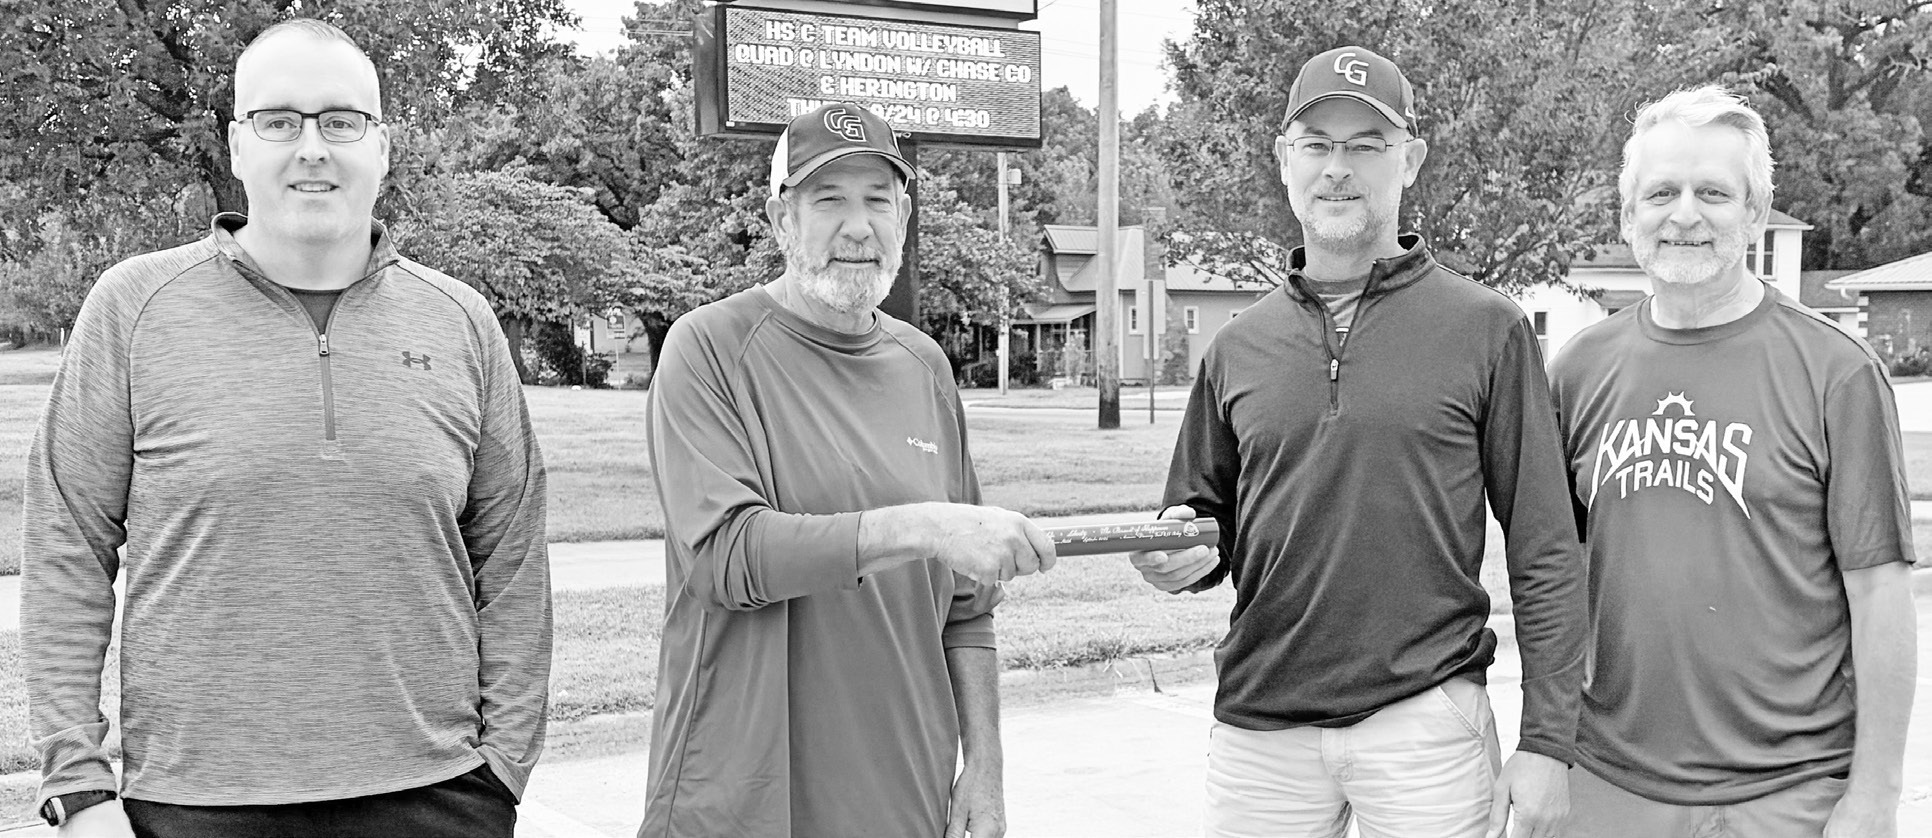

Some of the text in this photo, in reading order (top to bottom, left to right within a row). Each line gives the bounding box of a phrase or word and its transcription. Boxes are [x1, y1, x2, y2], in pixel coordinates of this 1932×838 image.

[765, 20, 1006, 58] HS C TEAM VOLLEYBALL
[735, 44, 1032, 84] QUAD @ LYNDON W/ CHASE CO
[1333, 52, 1370, 87] CG
[840, 76, 957, 102] HERINGTON
[823, 107, 867, 142] CG
[926, 106, 940, 125] @
[944, 107, 990, 129] 4:30
[1588, 417, 1753, 520] KANSAS
[1615, 458, 1714, 506] TRAILS
